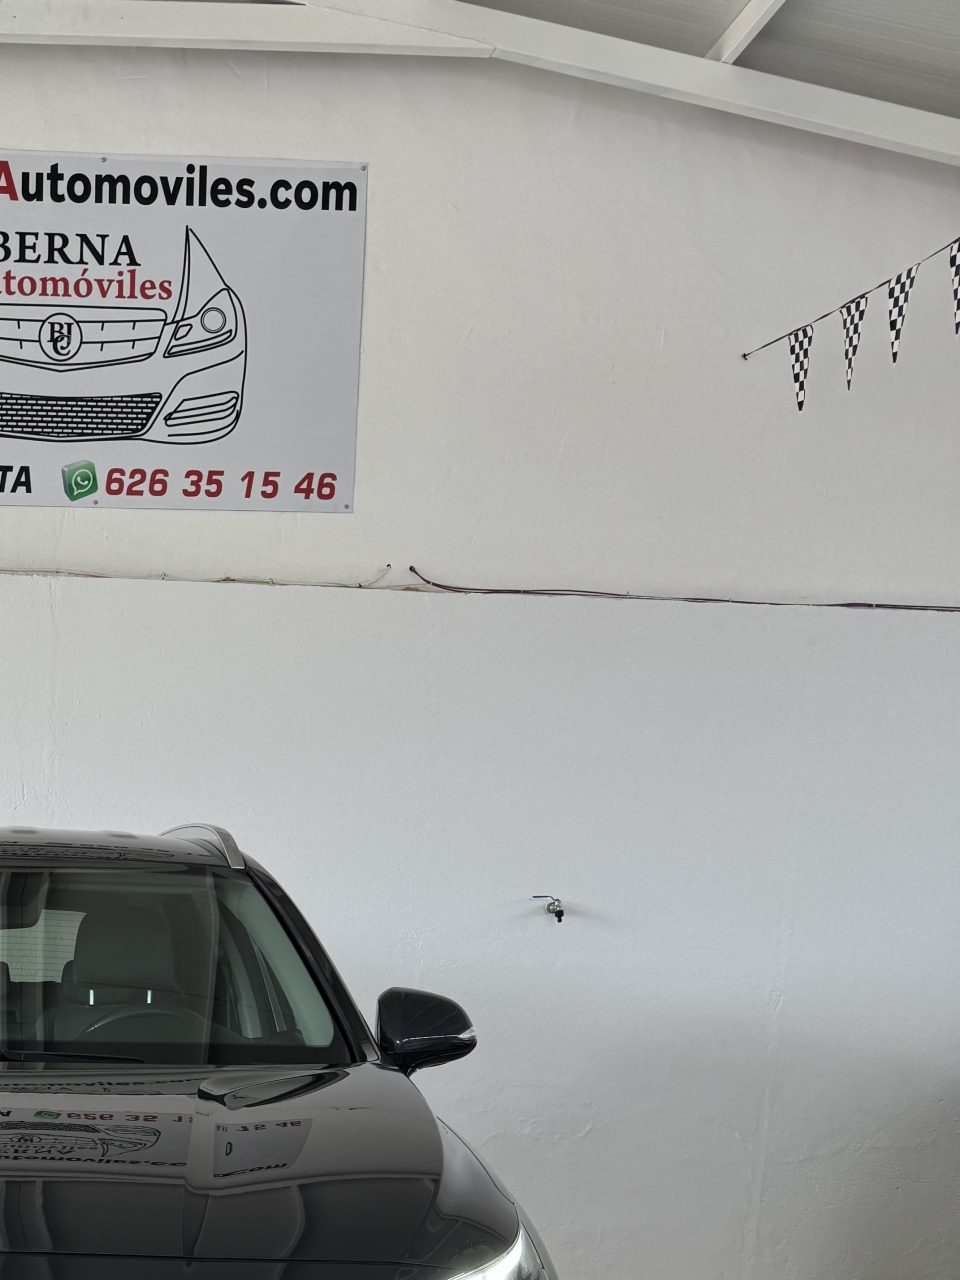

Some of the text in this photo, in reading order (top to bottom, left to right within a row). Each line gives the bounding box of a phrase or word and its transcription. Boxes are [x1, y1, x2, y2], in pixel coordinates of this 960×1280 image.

[105, 468, 338, 501] 626 35 15 46
